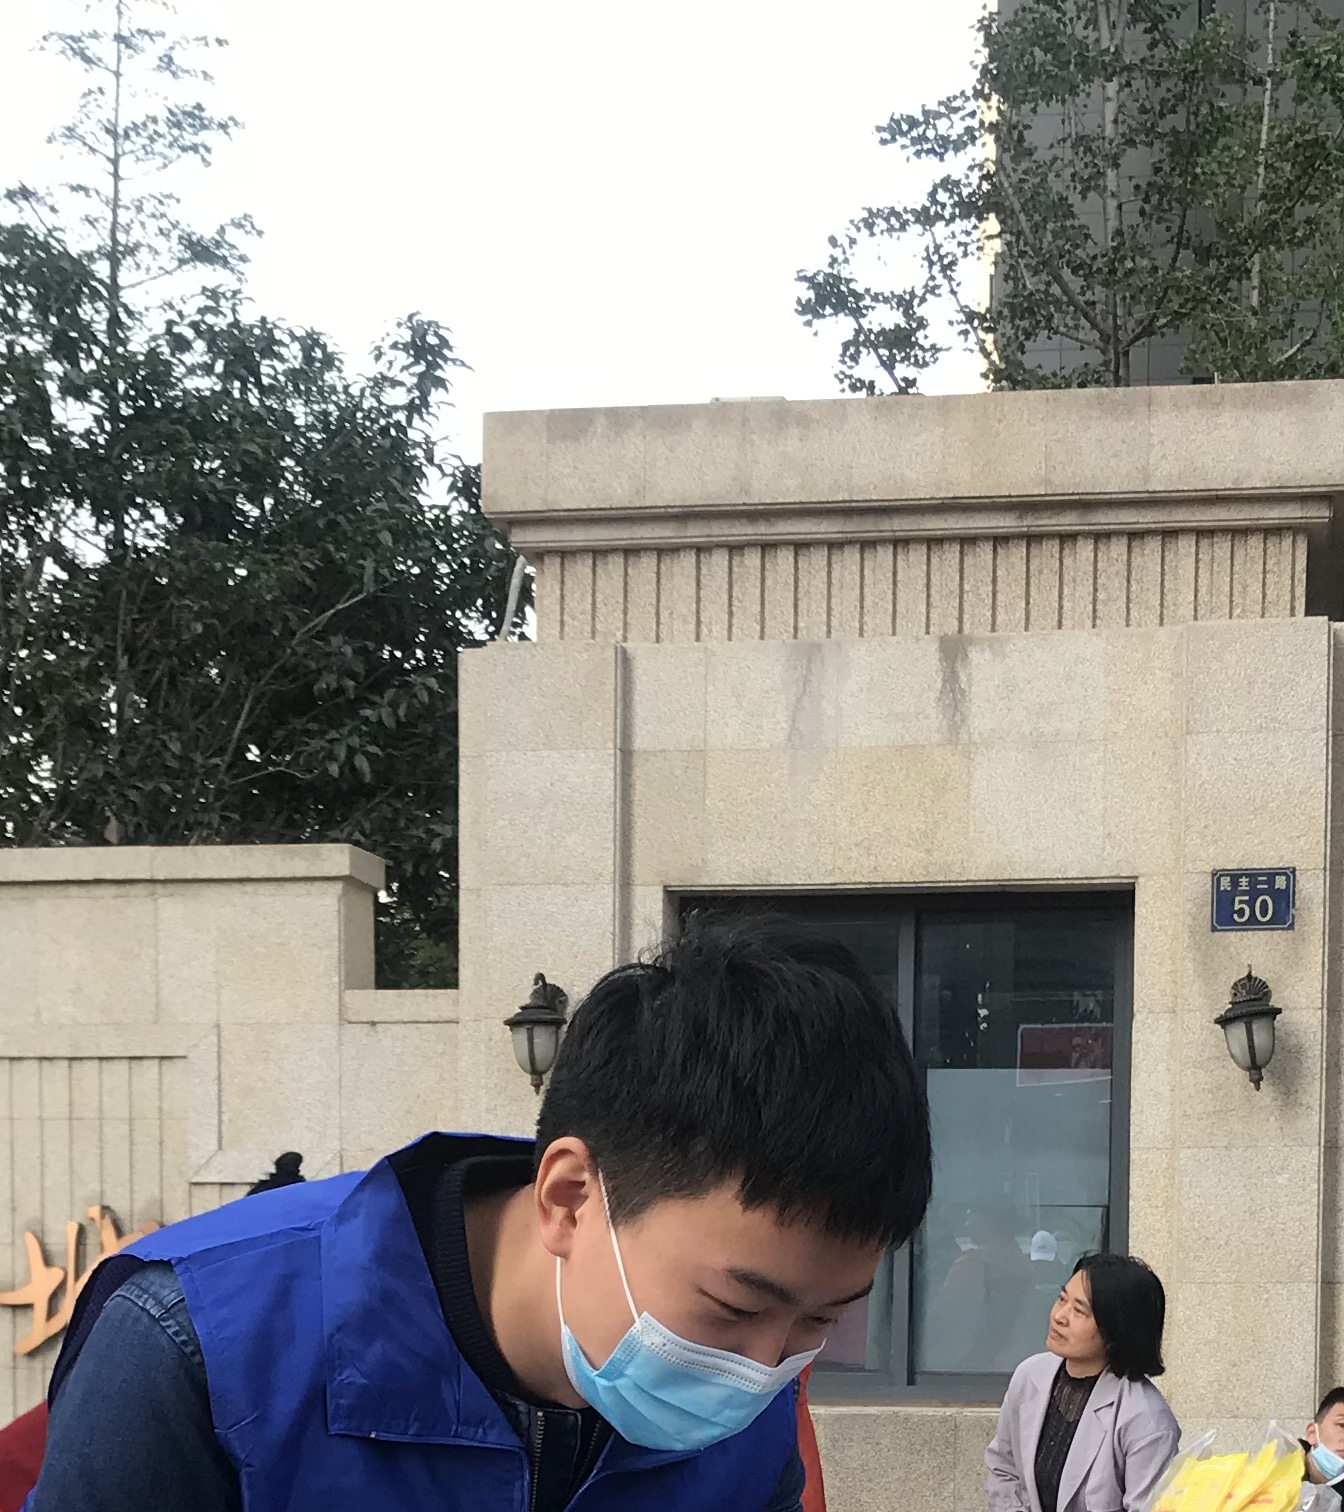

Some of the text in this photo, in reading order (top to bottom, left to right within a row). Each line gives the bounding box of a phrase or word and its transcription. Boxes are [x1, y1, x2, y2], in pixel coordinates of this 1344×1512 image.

[1220, 875, 1287, 891] 民主二路
[1232, 895, 1273, 922] 50
